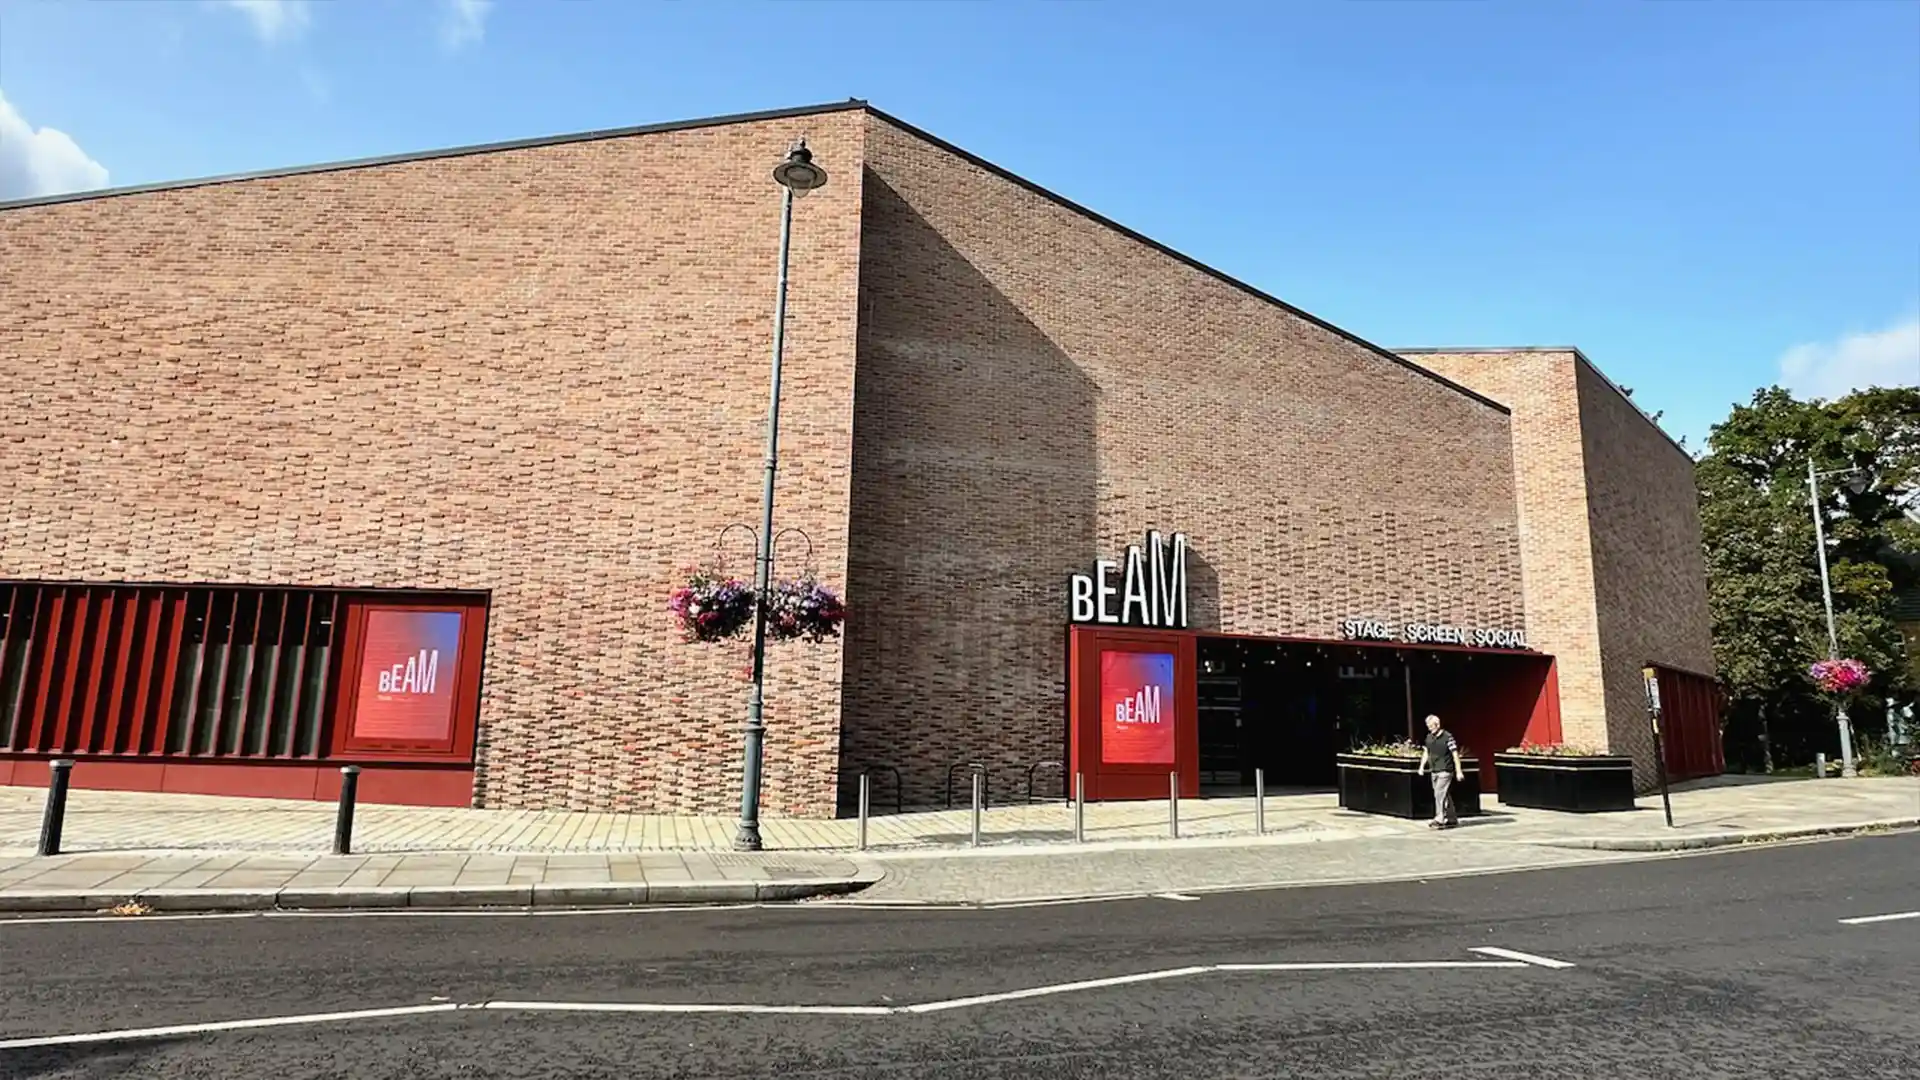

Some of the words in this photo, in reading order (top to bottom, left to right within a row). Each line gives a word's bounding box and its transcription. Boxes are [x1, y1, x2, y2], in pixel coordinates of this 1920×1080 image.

[1071, 529, 1188, 628] BEAM
[1344, 619, 1394, 639] STAGE
[1406, 623, 1465, 644] SCREEN
[1474, 628, 1528, 648] SOCIAL
[378, 649, 438, 694] BEAM
[1115, 685, 1160, 724] BEAM
